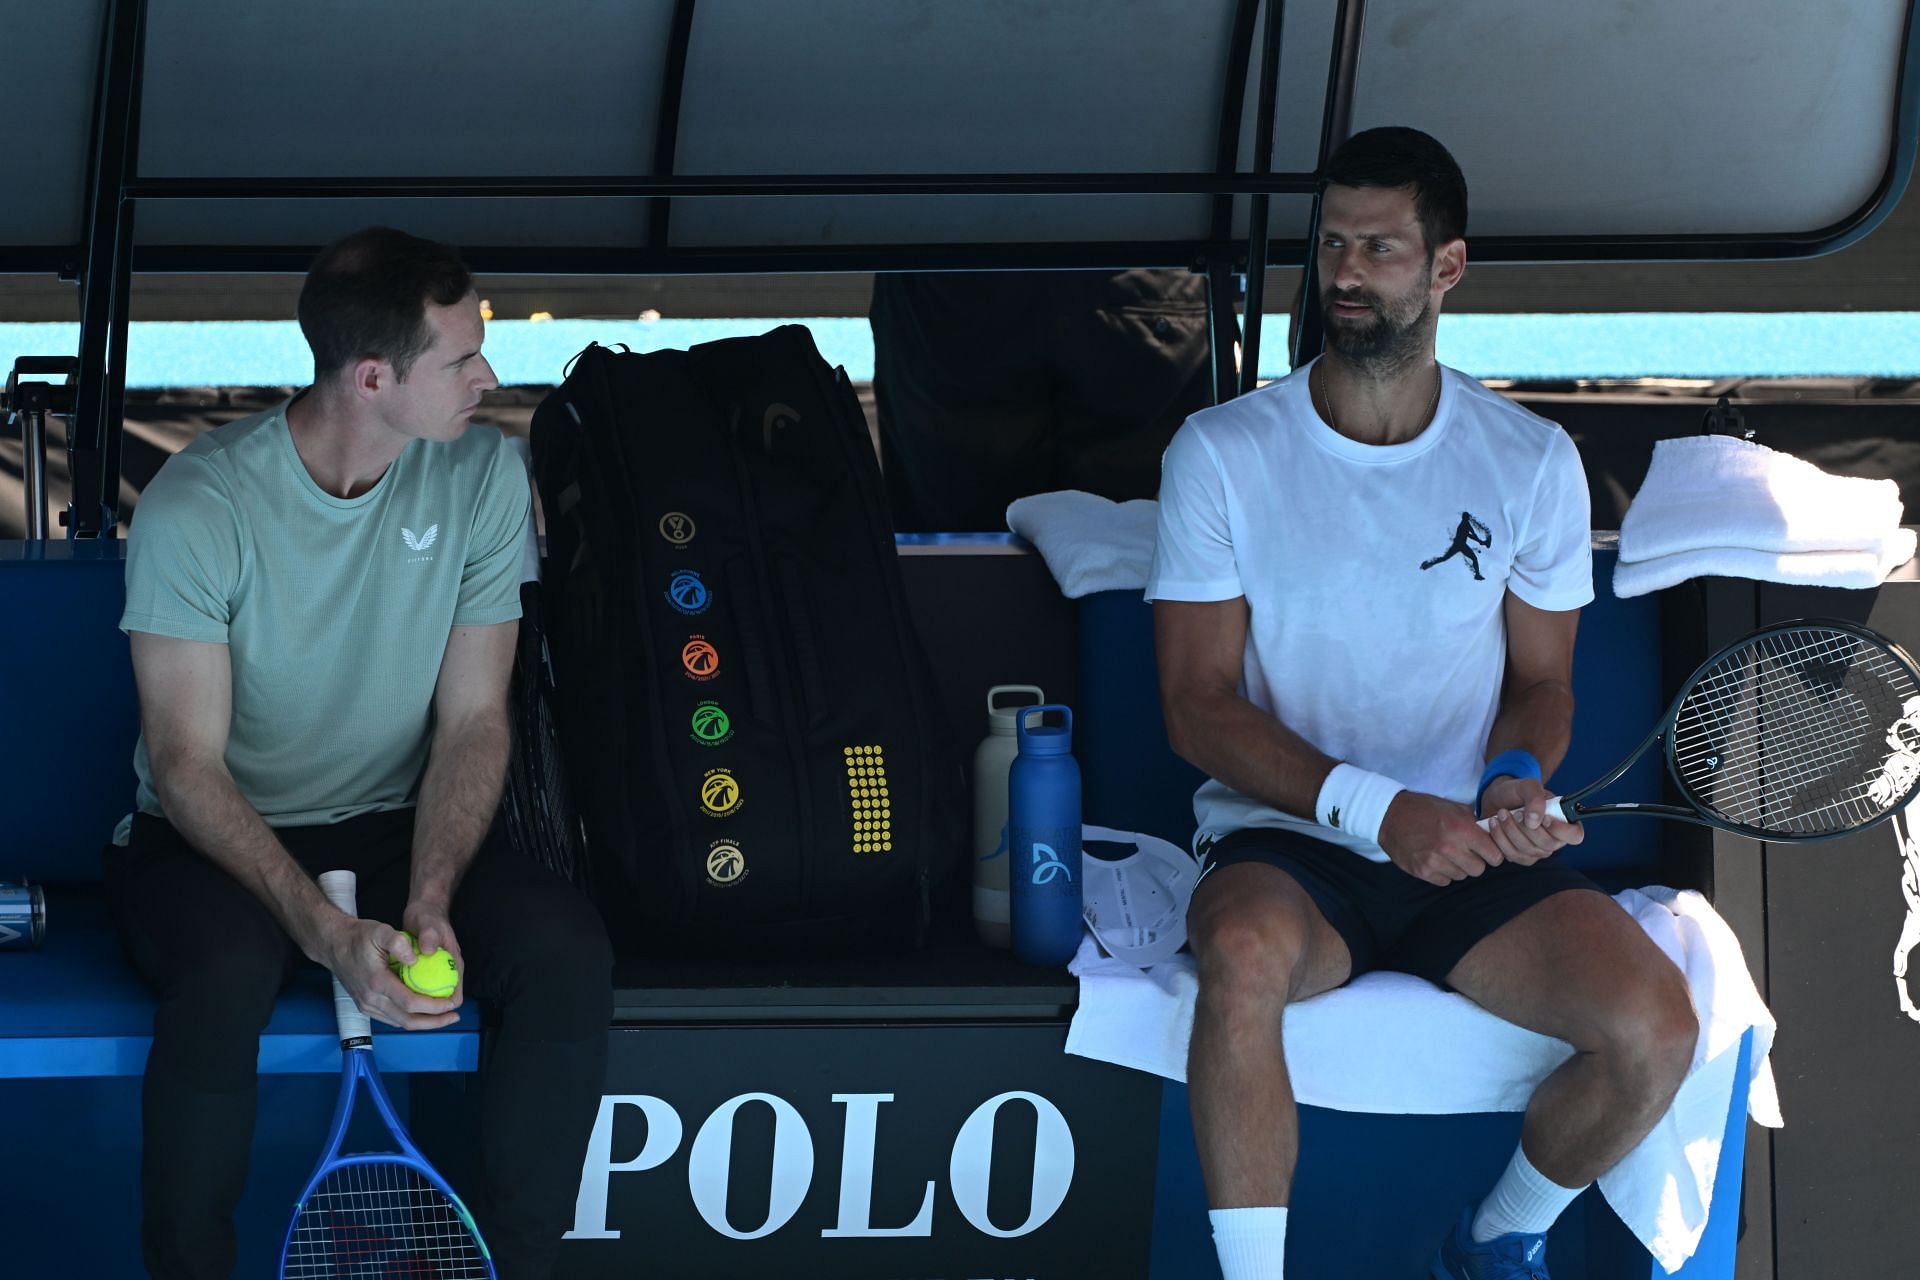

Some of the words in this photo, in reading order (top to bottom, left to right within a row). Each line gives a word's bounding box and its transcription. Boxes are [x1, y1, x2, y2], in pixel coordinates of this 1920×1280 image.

[703, 768, 716, 777] NEW
[716, 767, 732, 775] YORK
[709, 839, 720, 849] ATP
[720, 837, 740, 847] FINALS
[561, 1090, 1075, 1240] POLO
